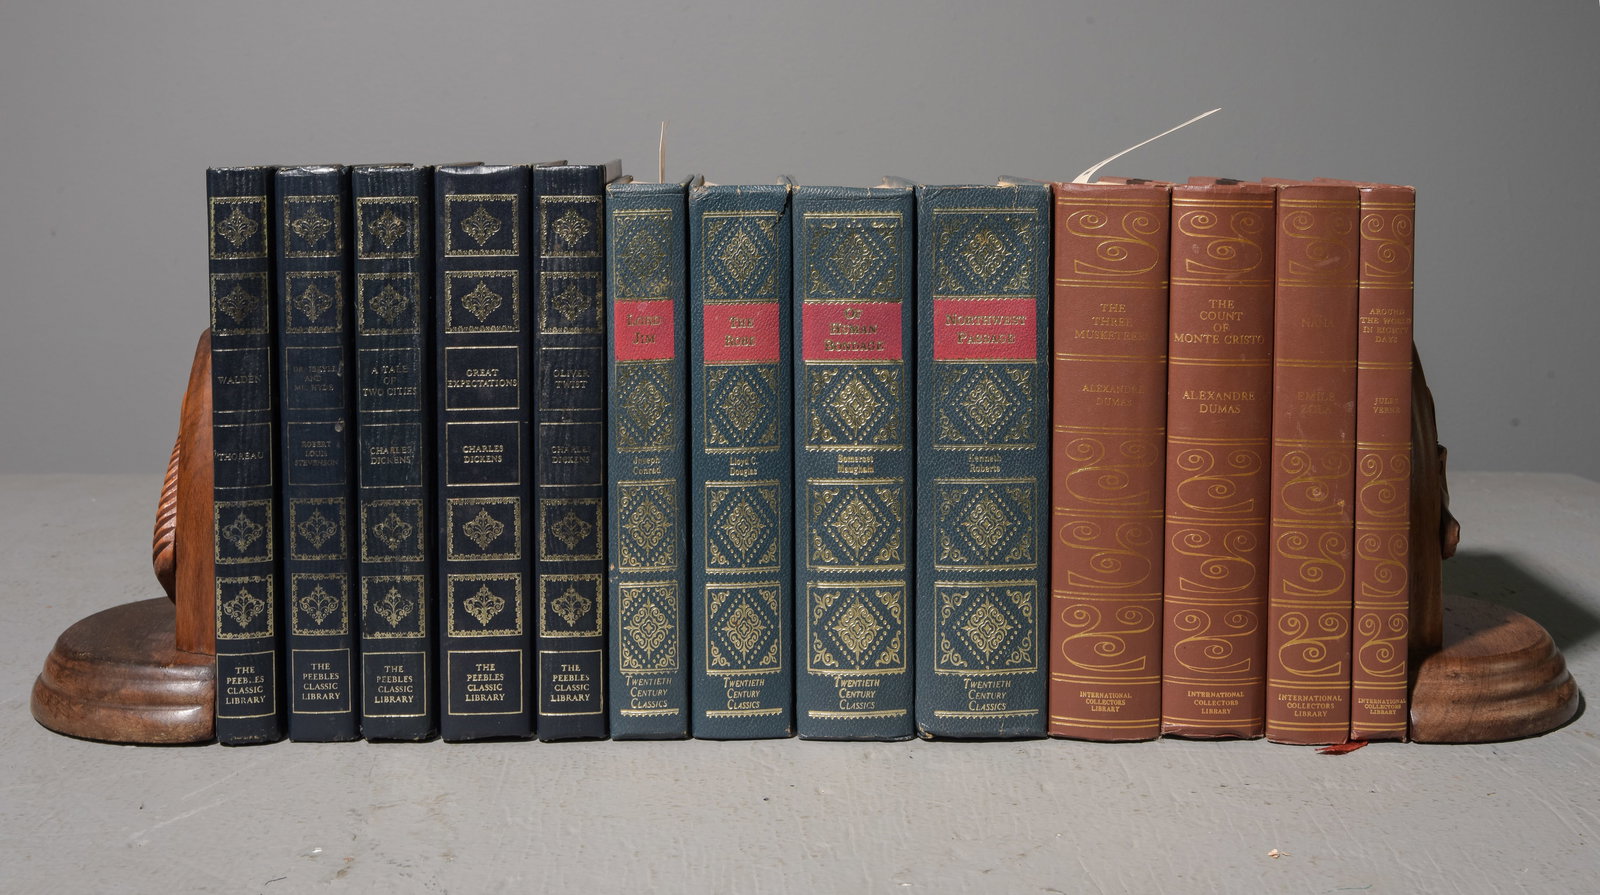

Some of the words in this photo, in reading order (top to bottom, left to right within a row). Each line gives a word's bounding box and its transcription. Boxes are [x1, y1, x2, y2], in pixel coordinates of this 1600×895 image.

[1100, 303, 1126, 313] THE
[1208, 299, 1235, 309] THE
[1199, 310, 1244, 321] COUNT
[1213, 323, 1230, 333] OF
[1174, 332, 1220, 344] MONTE
[1224, 334, 1265, 344] CRISTO
[371, 365, 379, 374] A
[382, 365, 408, 374] TALE
[466, 368, 499, 378] GREAT
[553, 368, 590, 378] OLIVER
[218, 375, 262, 386] WALDEN
[383, 376, 396, 385] OF
[447, 379, 518, 388] EXPECTATIONS
[555, 380, 588, 389] TWIST
[362, 387, 384, 396] TWO
[386, 386, 418, 396] CITIES
[1182, 390, 1256, 401] ALEXANDRE
[1199, 403, 1241, 414] DUMAS
[462, 444, 504, 454] CHARLES
[215, 452, 264, 462] THOREAU
[370, 456, 412, 465] DICKENS
[464, 454, 502, 464] DICKENS
[552, 456, 590, 464] DICKENS
[633, 456, 660, 467] Joseph
[730, 456, 750, 466] Lloyd
[838, 454, 874, 463] Somerset
[968, 453, 1002, 463] Kenneth
[633, 466, 662, 475] Conrad
[730, 466, 758, 478] Douglas
[838, 464, 874, 476] Maugham
[969, 464, 1000, 473] Roberts
[234, 666, 256, 674] THE
[310, 663, 331, 671] THE
[384, 665, 404, 674] THE
[475, 663, 496, 672] THE
[560, 664, 581, 672] THE
[302, 672, 340, 681] PEEBLES
[376, 675, 414, 684] PEEBLES
[466, 673, 504, 682] PEEBLES
[552, 674, 590, 682] PEEBLES
[227, 686, 264, 695] CLASSIC
[303, 682, 338, 691] CLASSIC
[378, 685, 414, 694] CLASSIC
[467, 683, 503, 692] CLASSIC
[554, 684, 590, 692] CLASSIC
[302, 692, 341, 700] LIBRARY
[465, 694, 506, 702] LIBRARY
[550, 694, 590, 702] LIBRARY
[1079, 690, 1132, 699] INTERNATIONAL
[1278, 694, 1342, 702] INTERNATIONAL
[225, 695, 266, 704] LIBRARY
[374, 695, 415, 704] LIBRARY
[1085, 698, 1126, 706] COLLECTORS
